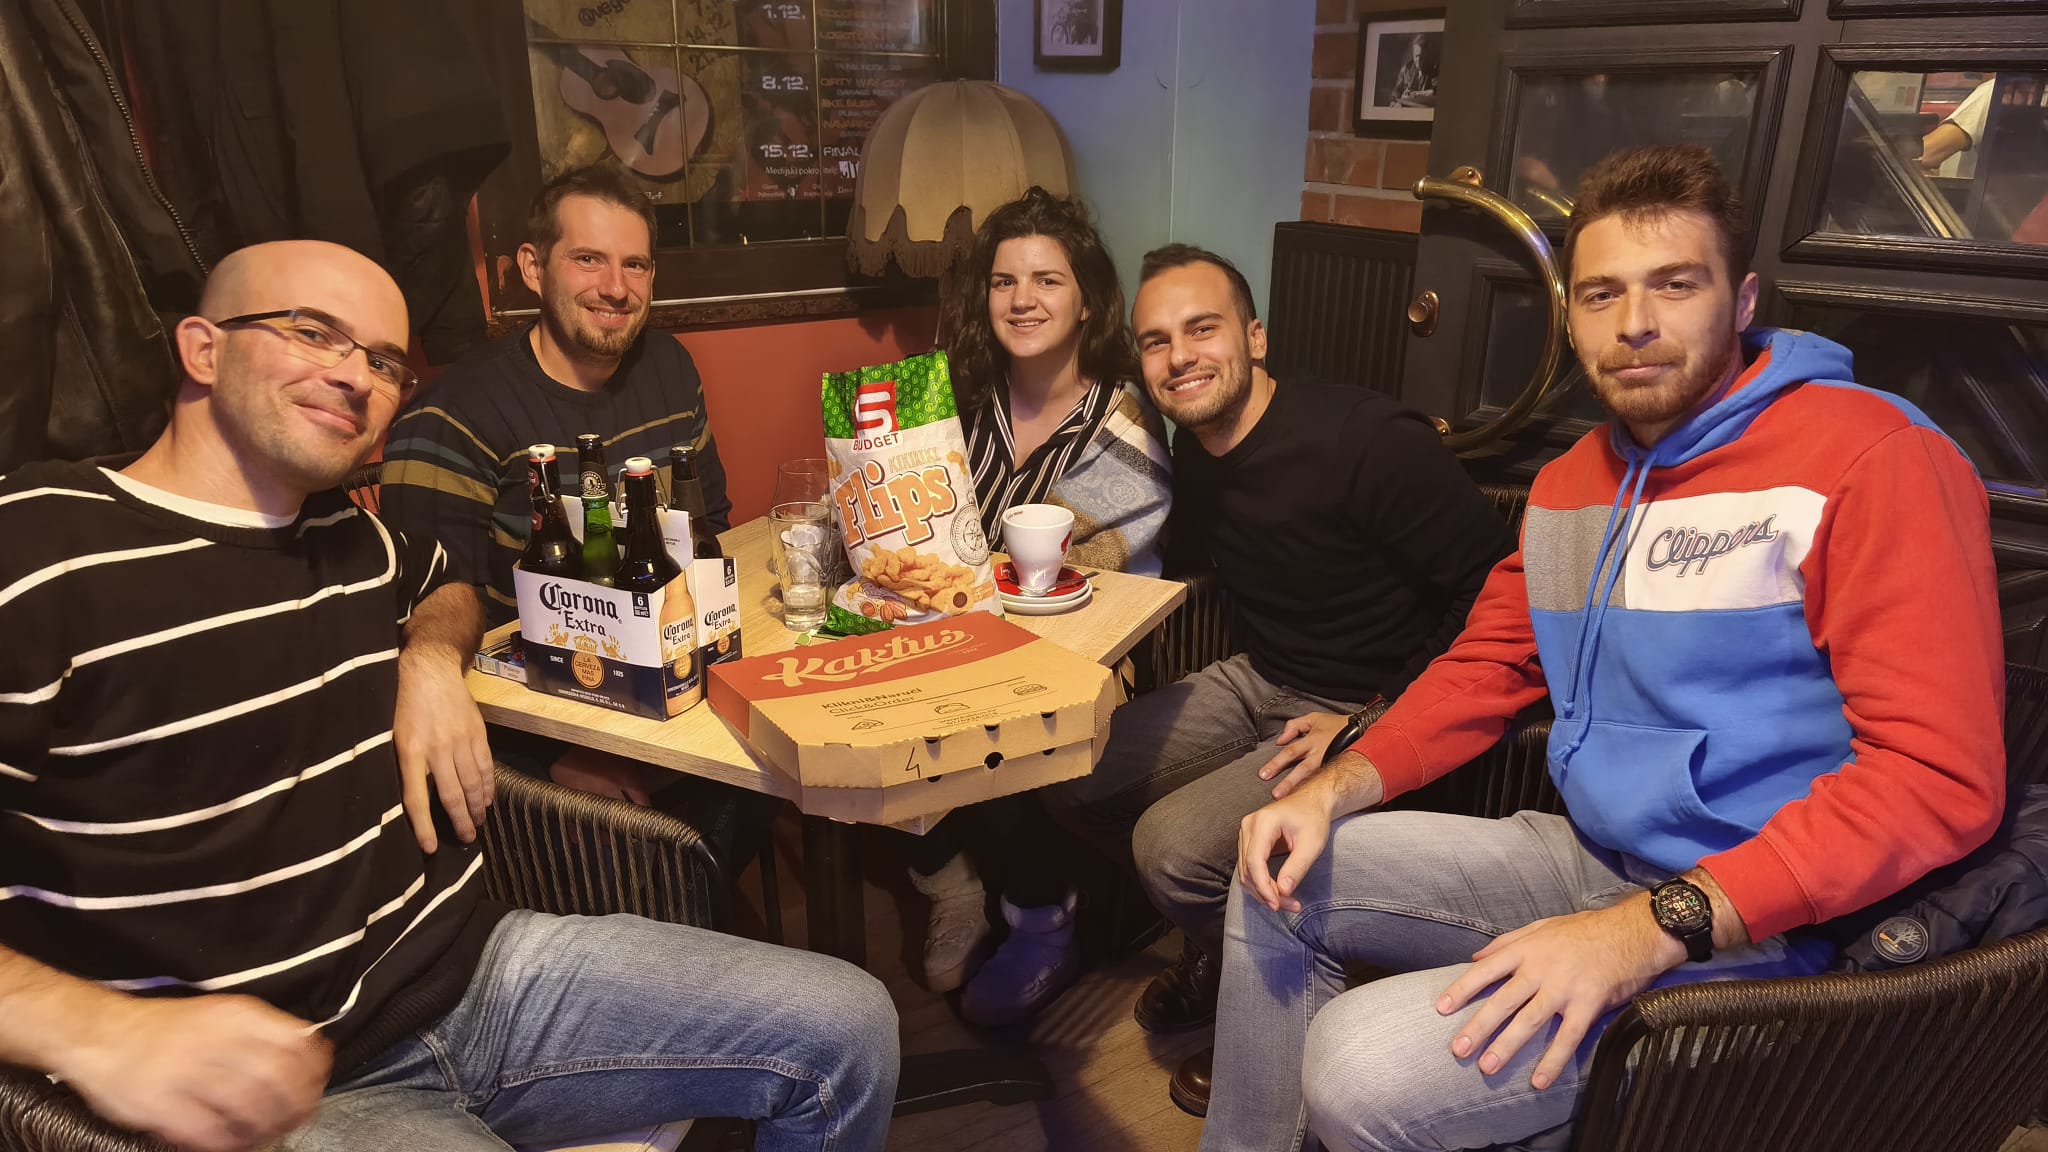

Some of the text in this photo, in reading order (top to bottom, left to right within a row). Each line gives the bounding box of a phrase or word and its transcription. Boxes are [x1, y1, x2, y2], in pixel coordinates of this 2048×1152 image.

[762, 4, 806, 20] 1.12.
[762, 75, 809, 91] 8.12.
[760, 144, 814, 158] 15.12.
[853, 432, 899, 451] BUDGET
[835, 460, 958, 549] flips
[1646, 514, 1779, 577] Clippers
[726, 565, 733, 575] 6
[539, 582, 619, 620] Corona
[637, 596, 644, 607] 6
[563, 610, 606, 637] Extra
[704, 603, 737, 627] Corona
[714, 617, 731, 630] Extra
[663, 618, 694, 640] Corona
[672, 632, 691, 646] Extra
[575, 660, 601, 671] CERVEZA
[761, 629, 974, 688] Kaktus
[828, 696, 915, 715] Click&Order
